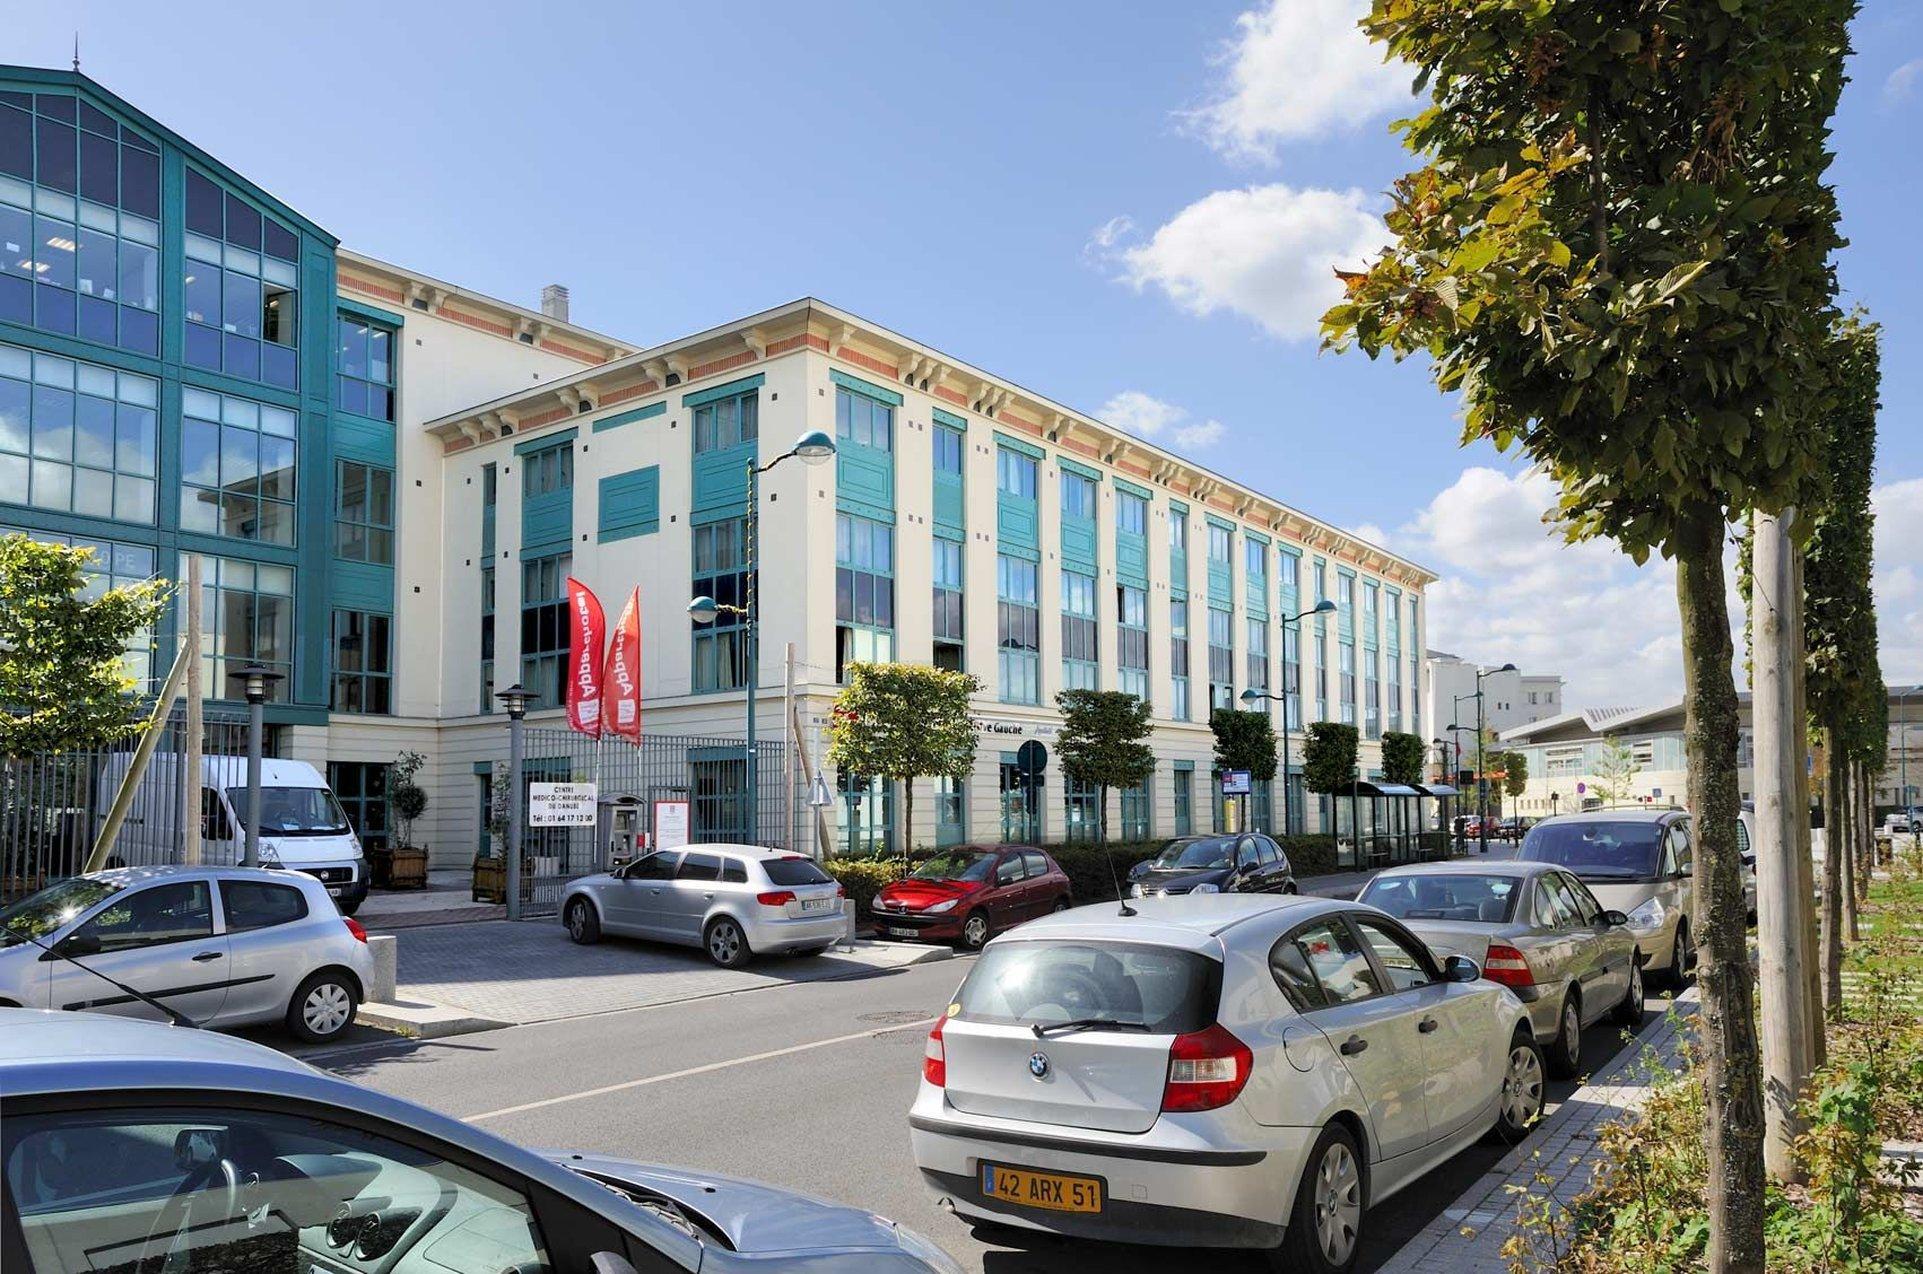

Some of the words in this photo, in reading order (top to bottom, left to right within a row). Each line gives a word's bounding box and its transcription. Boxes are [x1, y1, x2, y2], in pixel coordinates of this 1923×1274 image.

[993, 723, 1022, 735] Gauche
[999, 1173, 1020, 1198] 42
[1029, 1177, 1064, 1204] ARX
[1072, 1183, 1096, 1207] 51
